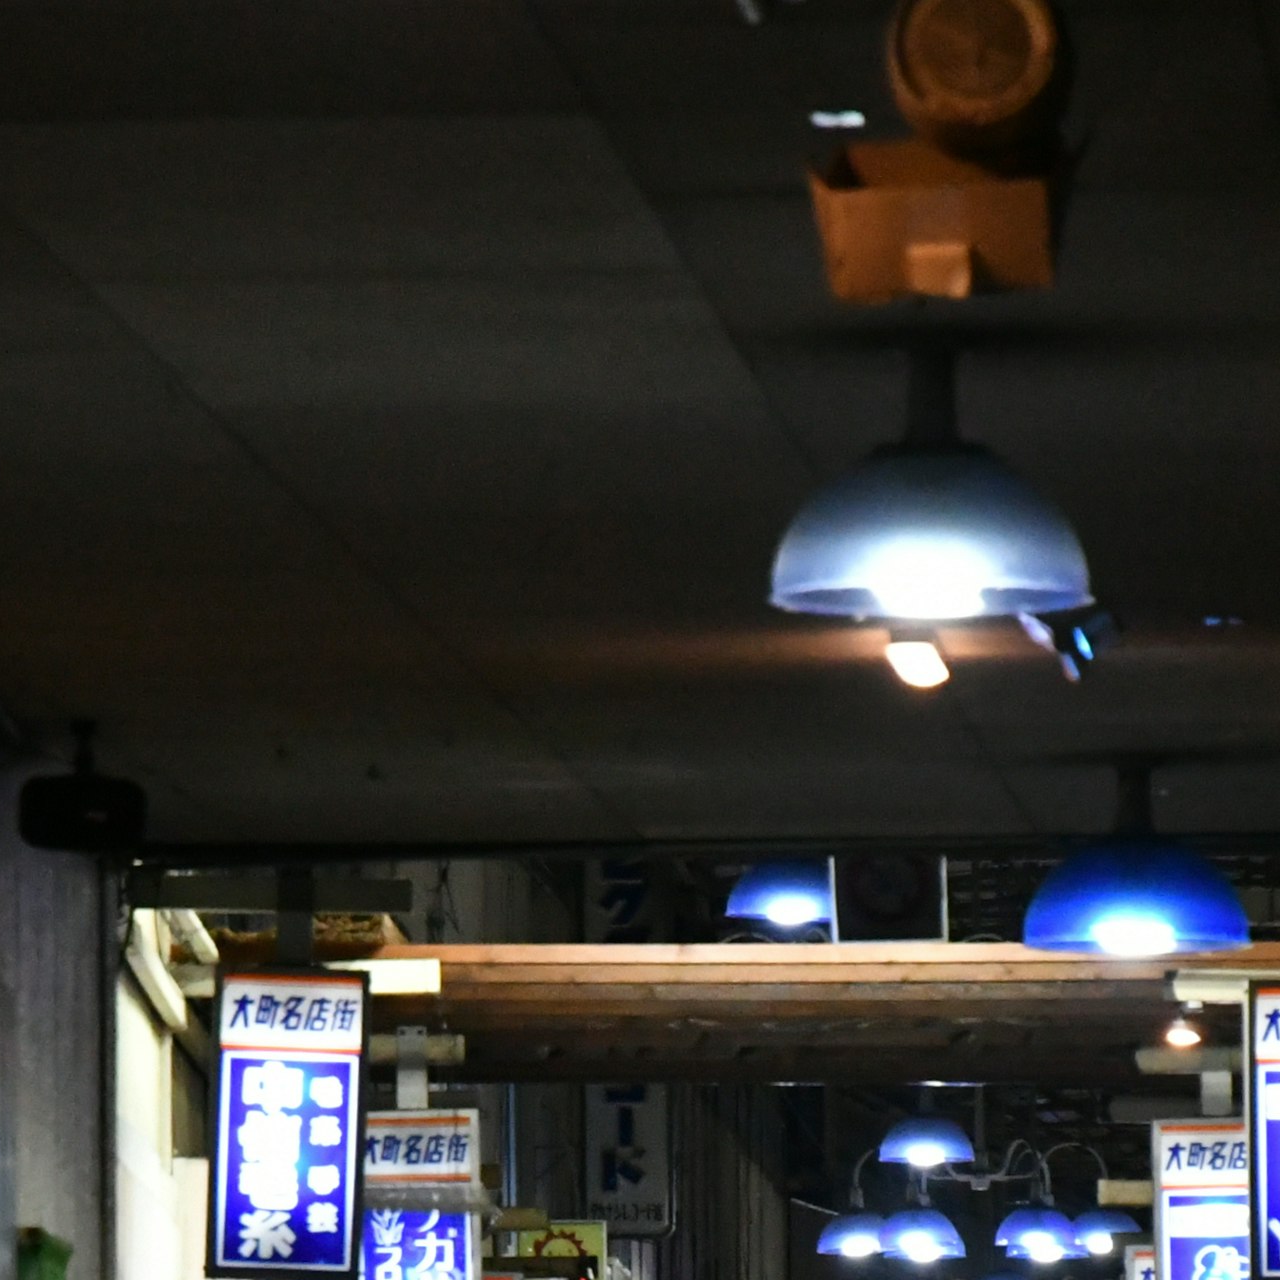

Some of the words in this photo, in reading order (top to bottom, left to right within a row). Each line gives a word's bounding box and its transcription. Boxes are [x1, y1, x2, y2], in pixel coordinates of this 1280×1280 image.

[230, 995, 357, 1031] 大町名店街
[366, 1135, 468, 1163] 大町名店街
[1165, 1141, 1247, 1171] 大町名店
